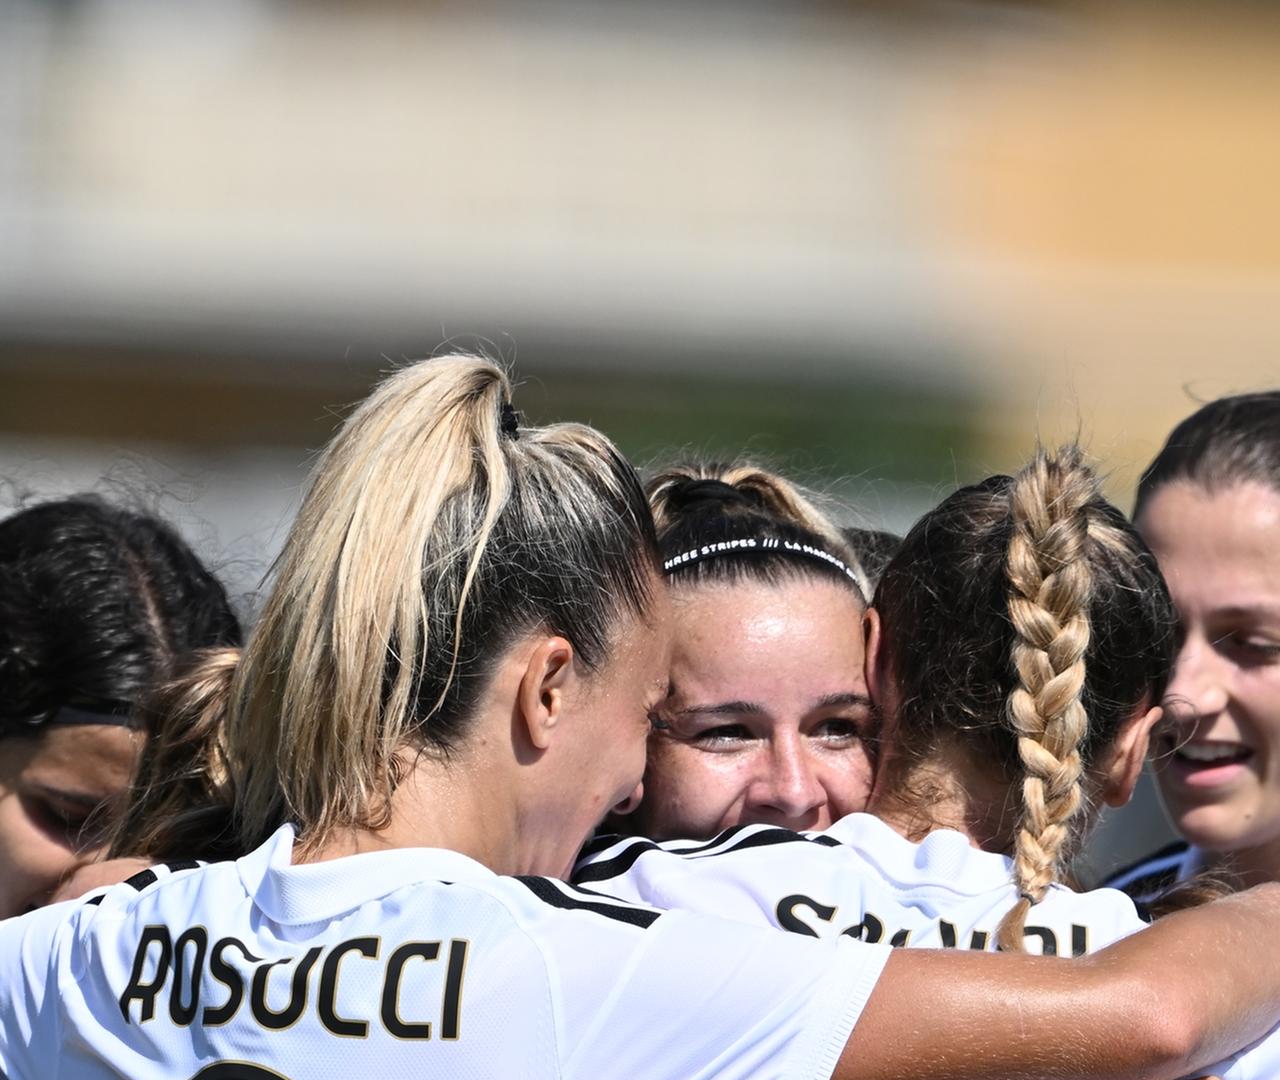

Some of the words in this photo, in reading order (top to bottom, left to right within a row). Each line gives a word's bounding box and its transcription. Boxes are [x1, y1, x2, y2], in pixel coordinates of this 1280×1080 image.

[664, 549, 698, 570] HREE
[700, 538, 757, 555] STRIPES
[120, 924, 471, 1042] ROSUCCI
